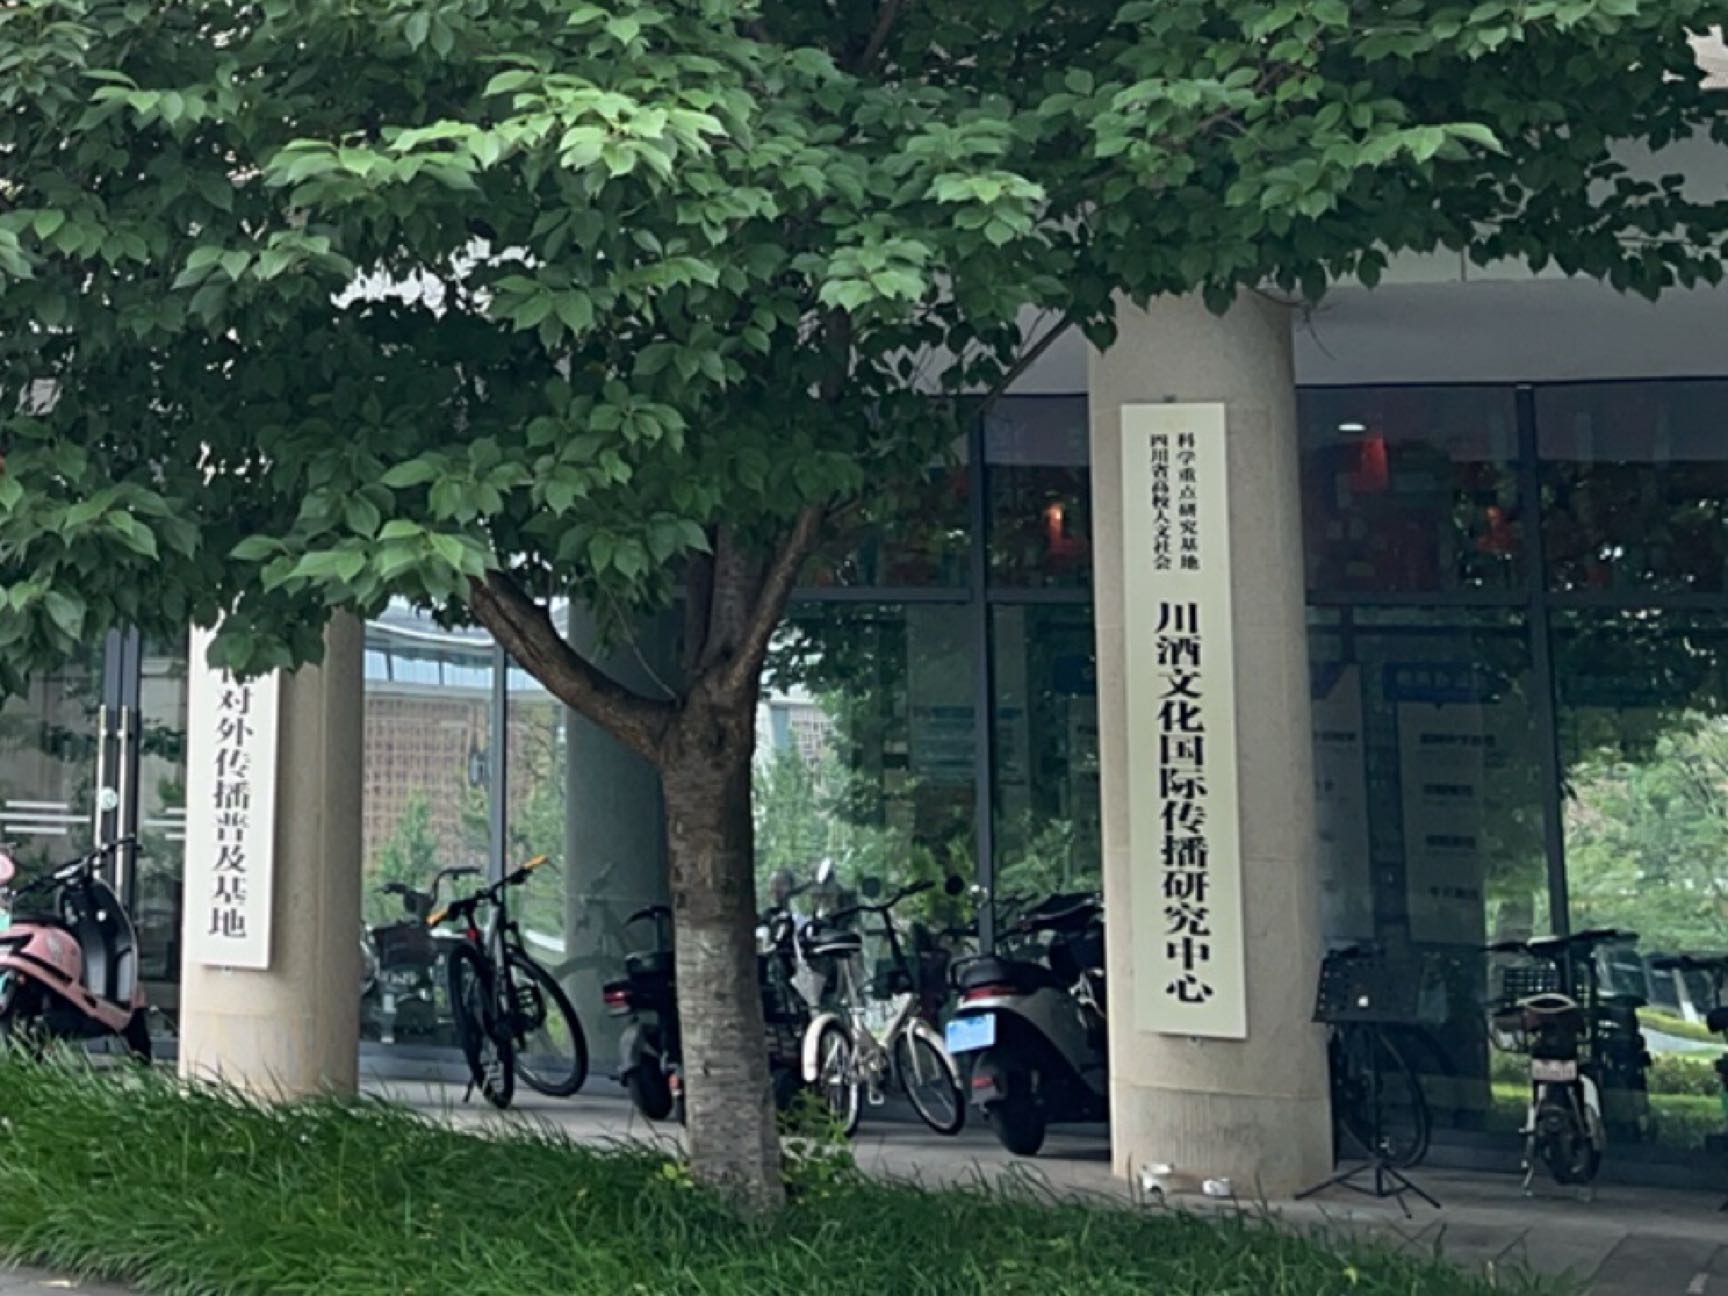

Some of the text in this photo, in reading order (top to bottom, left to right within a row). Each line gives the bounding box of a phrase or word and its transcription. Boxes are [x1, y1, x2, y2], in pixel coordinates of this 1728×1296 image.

[1177, 432, 1200, 570] 科学重点研究基地
[207, 666, 254, 939] 对外传播普及基地
[1154, 602, 1214, 1004] 川酒文化国际传播研究中心
